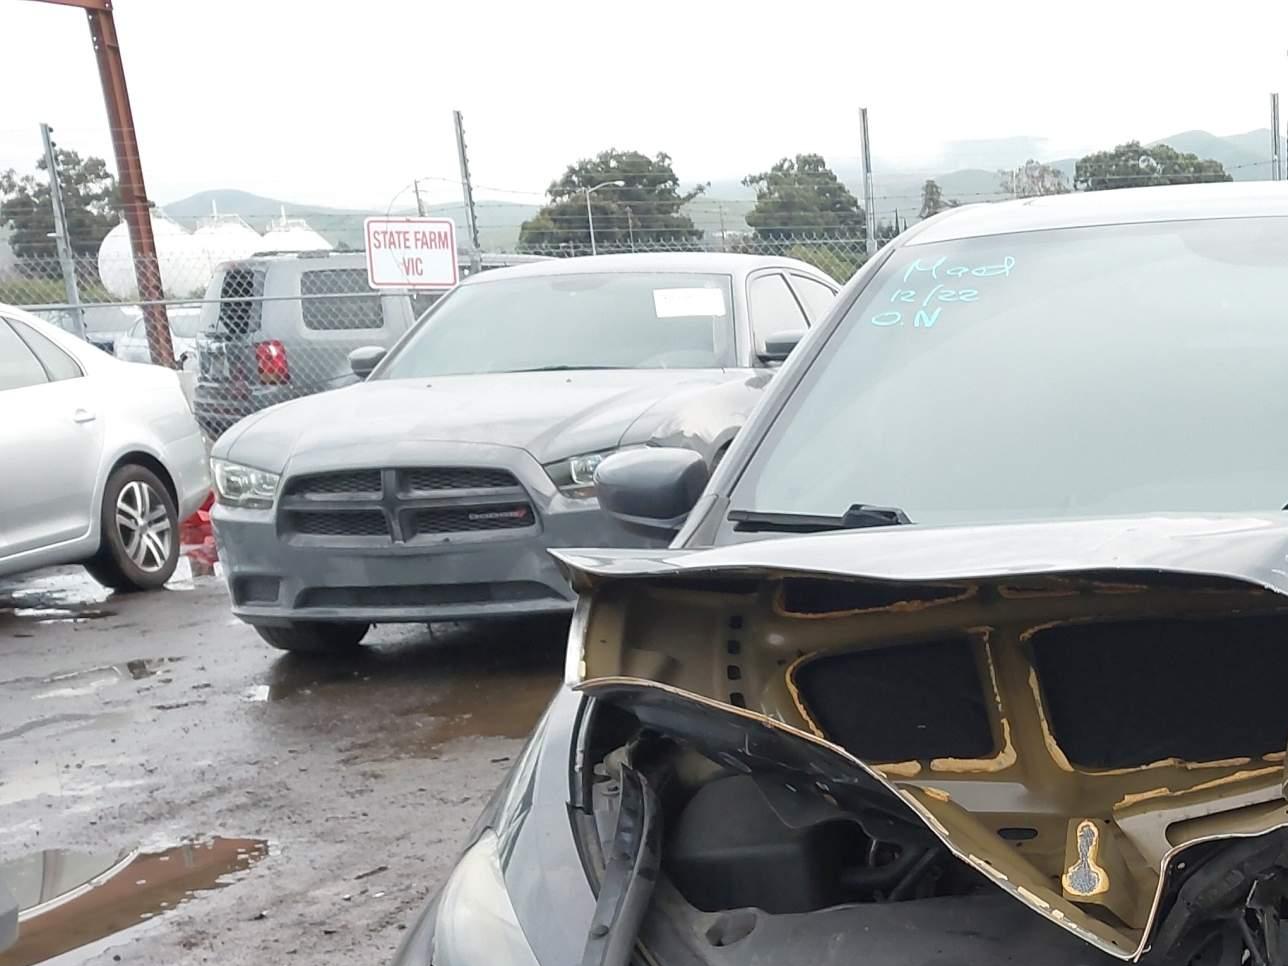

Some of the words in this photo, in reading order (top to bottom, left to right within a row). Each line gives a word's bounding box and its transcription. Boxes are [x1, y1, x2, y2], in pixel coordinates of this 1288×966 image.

[373, 230, 410, 249] STATE
[414, 230, 449, 250] FARM
[402, 257, 424, 276] VIC
[890, 284, 980, 307] 12/22
